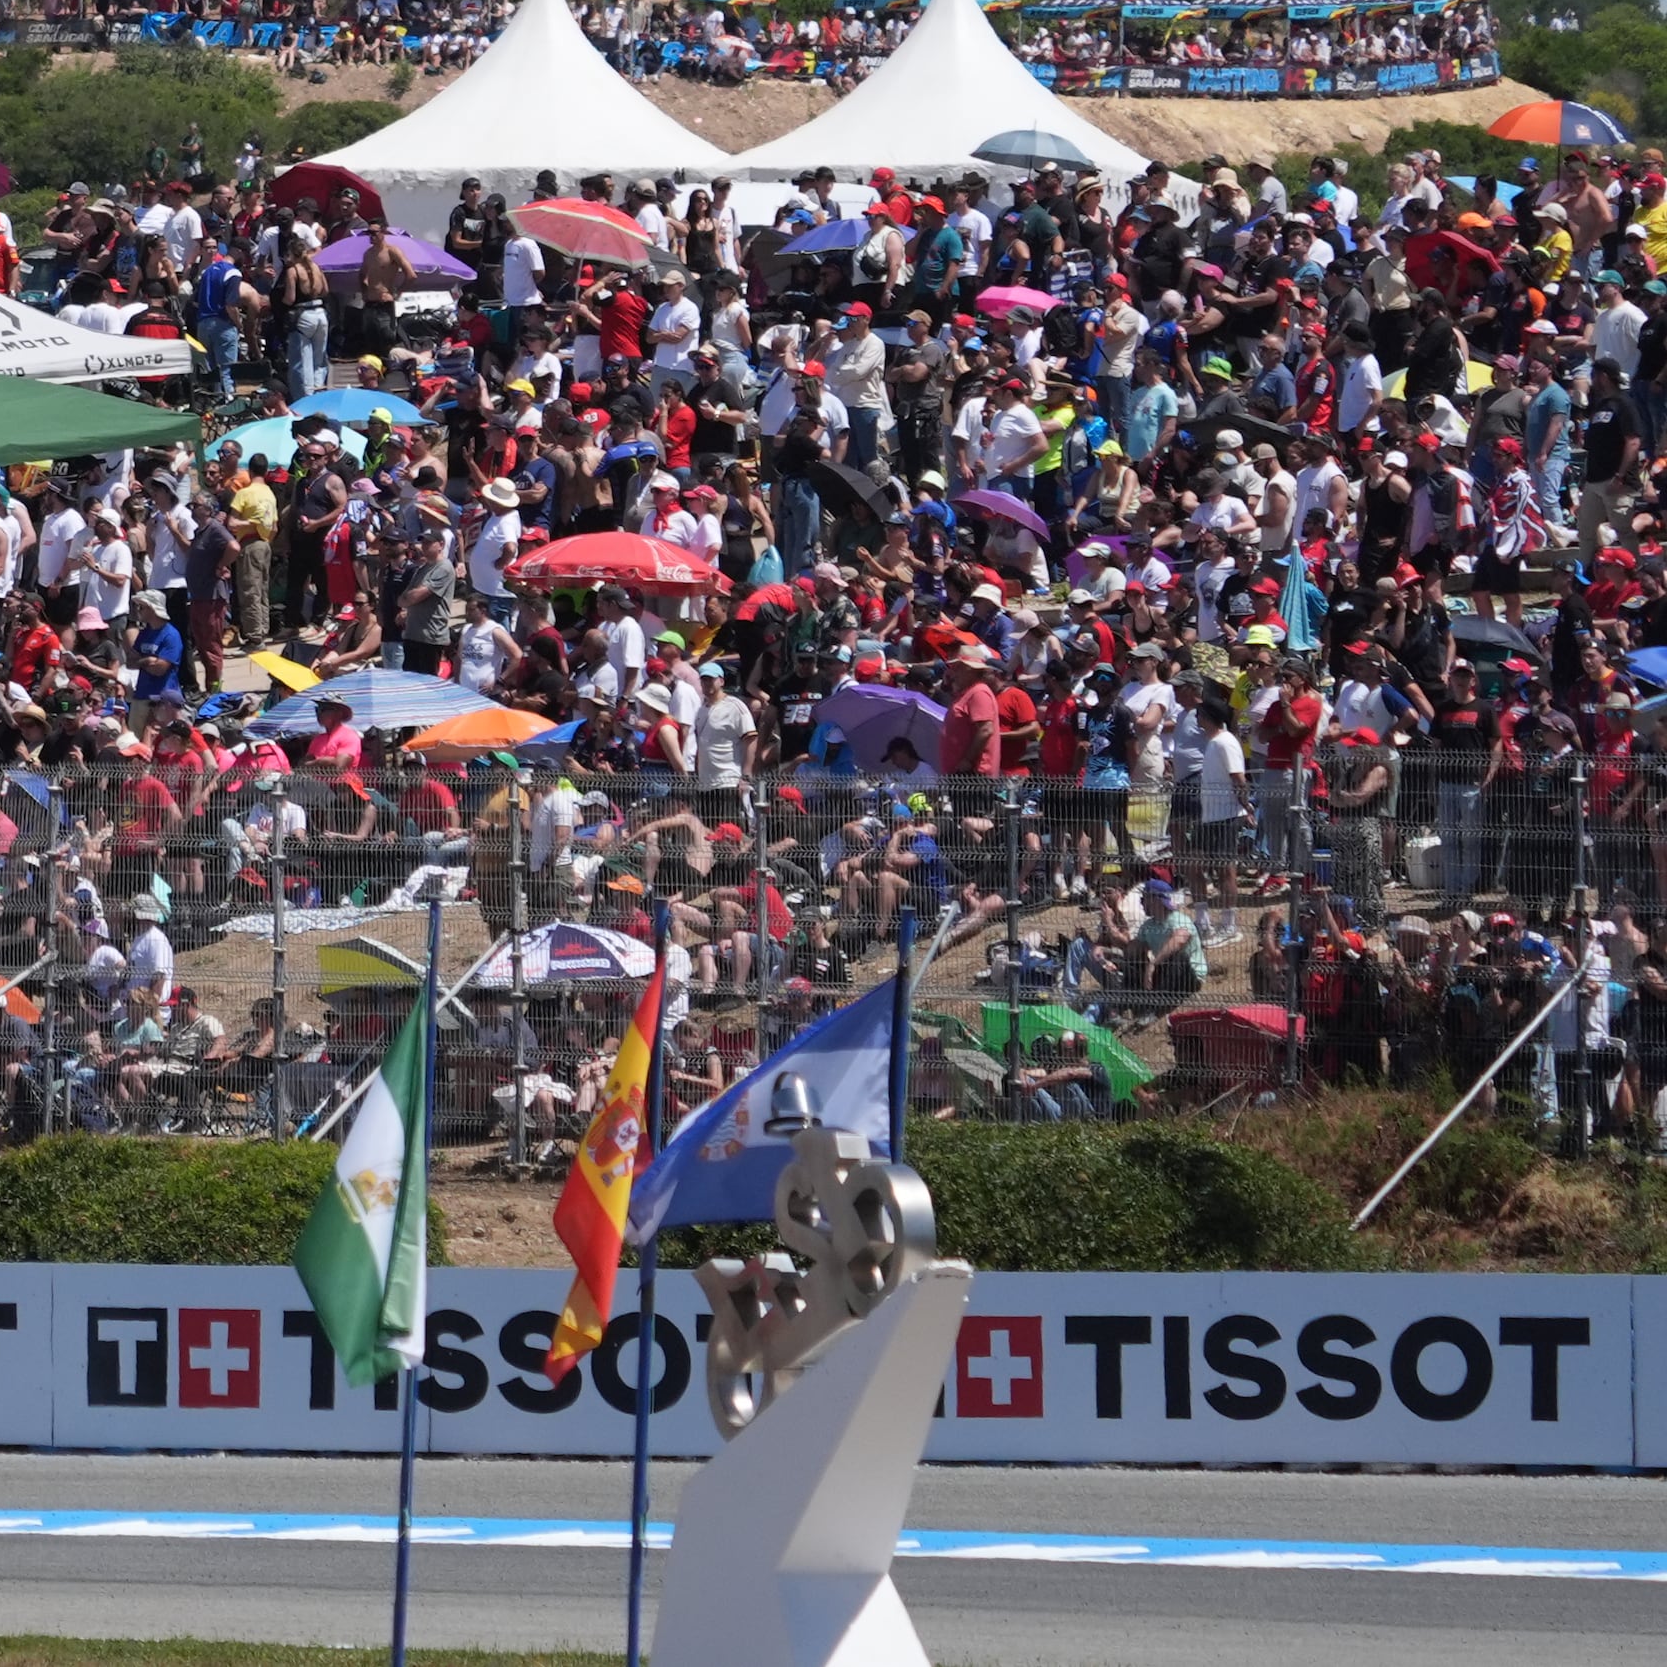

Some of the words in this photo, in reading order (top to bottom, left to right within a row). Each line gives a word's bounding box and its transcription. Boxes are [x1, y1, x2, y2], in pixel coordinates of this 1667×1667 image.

[1188, 67, 1280, 93] KARTING
[107, 354, 164, 369] XLMOTO
[282, 1309, 715, 1415] TSSO
[1064, 1314, 1591, 1423] TISSOT
